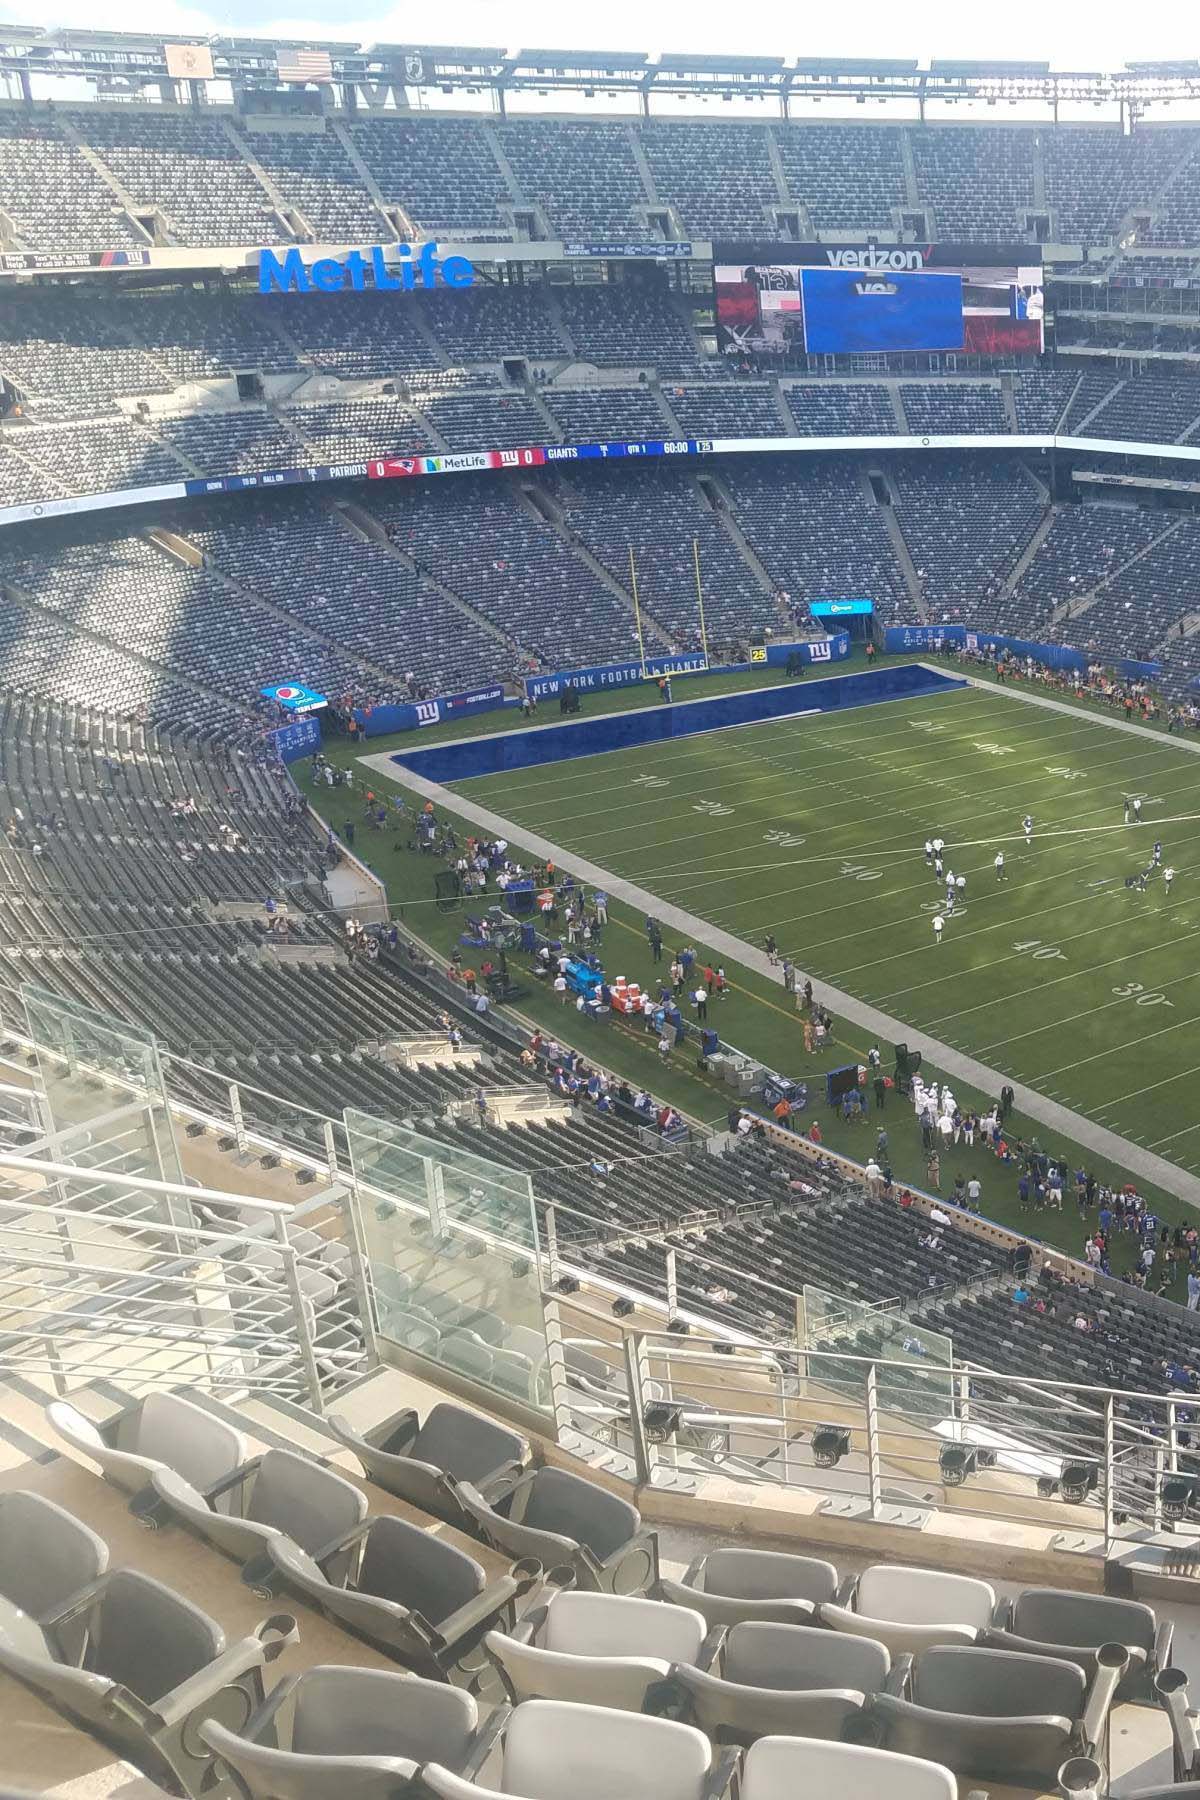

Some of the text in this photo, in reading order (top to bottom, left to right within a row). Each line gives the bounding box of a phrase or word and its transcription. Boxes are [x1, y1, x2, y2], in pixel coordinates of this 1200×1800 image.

[826, 245, 923, 269] verizon
[259, 242, 475, 293] MetLife
[548, 447, 578, 459] GIANTS
[663, 442, 688, 453] 60:00
[444, 455, 486, 468] MetLife
[525, 450, 533, 464] 0
[329, 464, 368, 478] PATRIOTS
[376, 462, 385, 476] 0
[753, 649, 766, 660] 25
[533, 659, 706, 696] NEW YORK FOOTBALL GIANTS
[632, 776, 670, 788] 10
[692, 800, 735, 815] 20
[763, 831, 806, 846] 30
[840, 865, 883, 880] 40
[1013, 941, 1060, 959] 40
[1112, 983, 1165, 1005] 30
